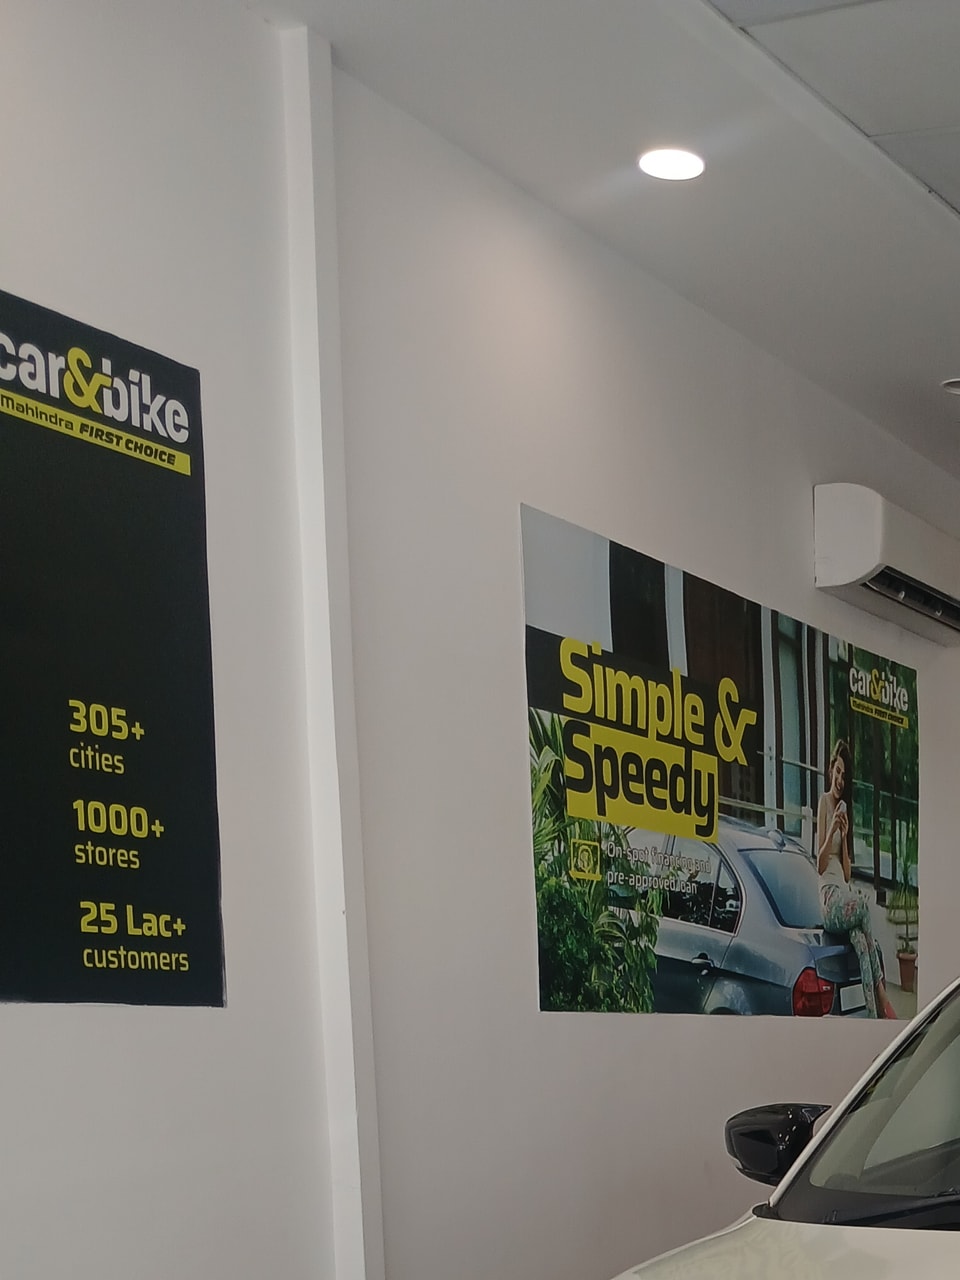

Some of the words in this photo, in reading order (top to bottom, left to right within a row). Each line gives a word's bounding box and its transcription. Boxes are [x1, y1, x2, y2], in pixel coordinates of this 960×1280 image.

[0, 332, 189, 443] car&bike
[79, 422, 123, 447] FIRST
[125, 438, 176, 465] CHOICE
[560, 637, 705, 743] Simple
[714, 677, 757, 766] &
[849, 667, 908, 711] car&bike
[68, 699, 145, 740] 305+
[69, 742, 125, 774] cities
[563, 719, 715, 838] Speedy
[72, 799, 164, 838] 1000+
[74, 841, 140, 869] stores
[80, 901, 118, 934] 25
[126, 904, 186, 938] Lac+
[83, 945, 190, 972] customers
